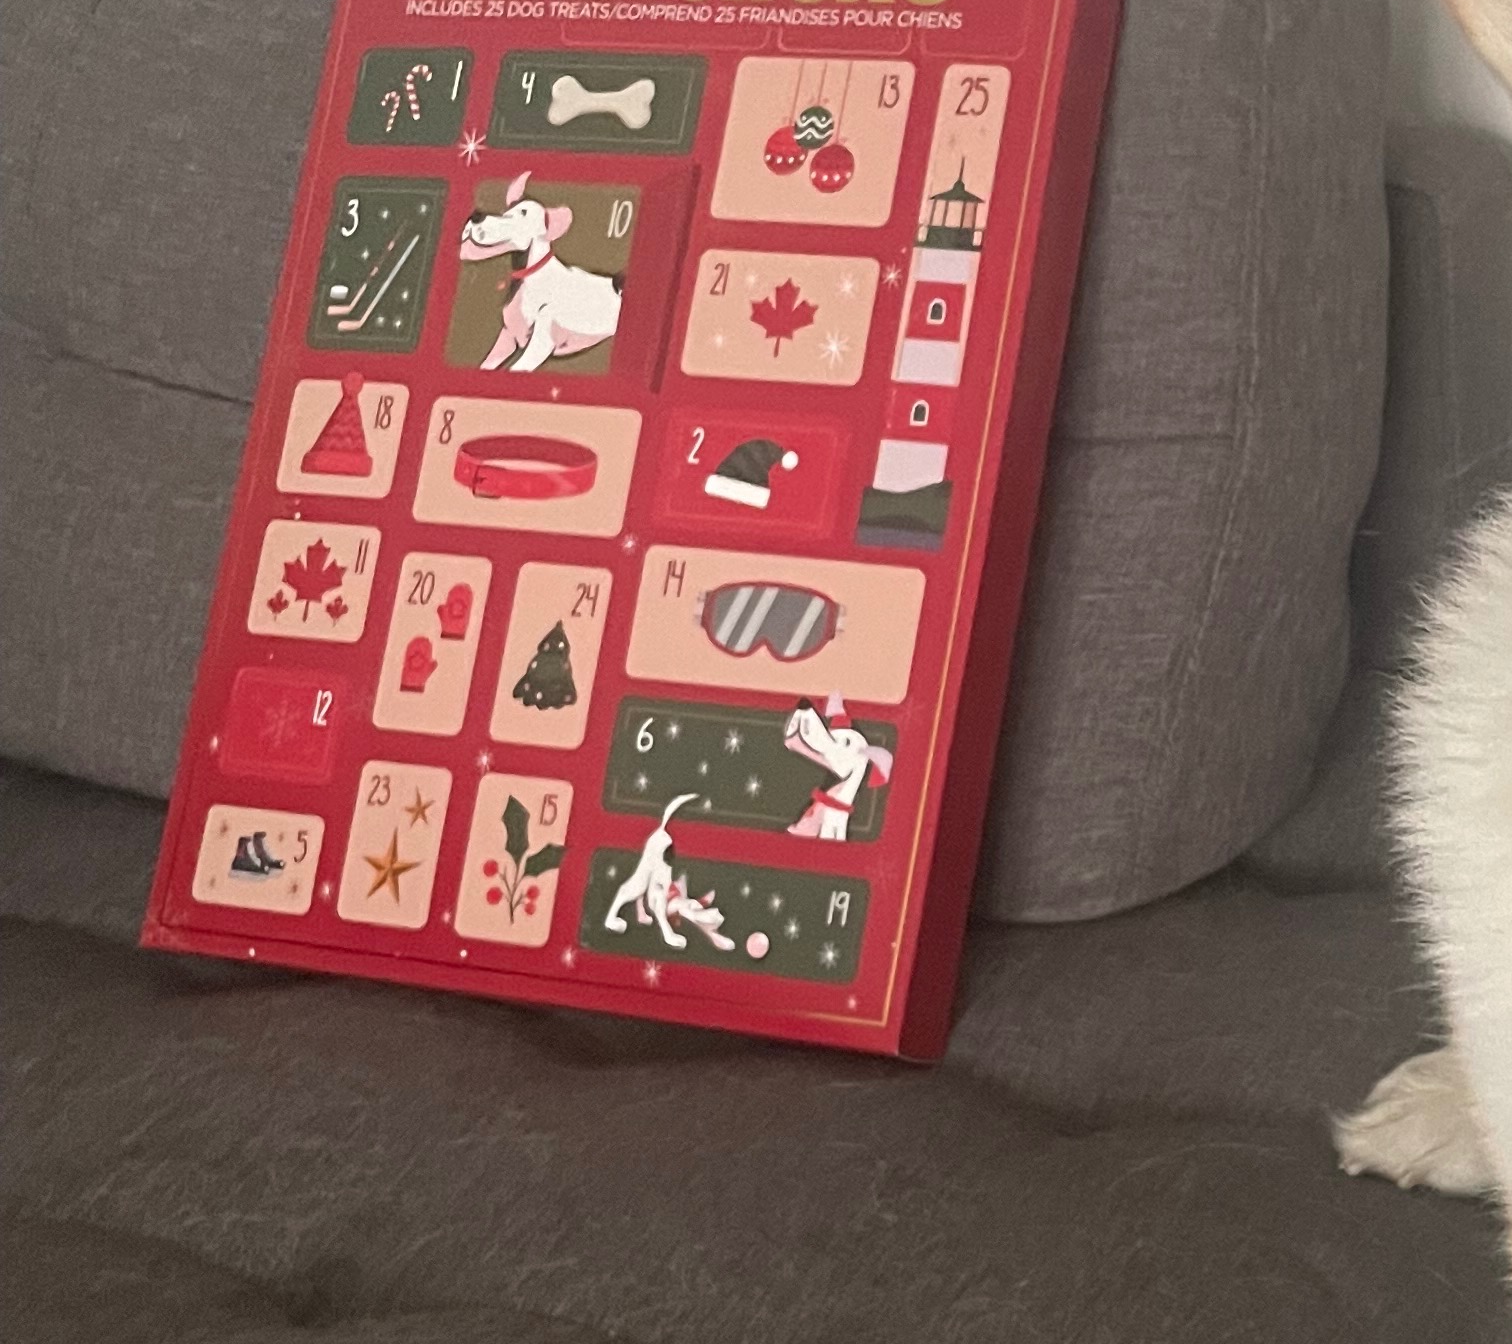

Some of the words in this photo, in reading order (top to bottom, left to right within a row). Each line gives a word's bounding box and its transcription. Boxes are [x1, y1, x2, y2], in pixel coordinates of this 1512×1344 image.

[405, 0, 483, 17] INCLUDES
[484, 0, 505, 17] 25
[507, 0, 545, 18] DOG
[714, 6, 736, 24] 25
[738, 6, 840, 26] FRIANDISES
[843, 9, 893, 27] POUR
[896, 11, 963, 30] CHIENS
[451, 60, 463, 101] 1
[521, 71, 536, 105] 4
[877, 74, 901, 109] 13
[955, 76, 990, 117] 25
[341, 199, 360, 238] 3
[607, 200, 633, 239] 10
[709, 262, 731, 296] 21
[373, 395, 394, 430] 18
[438, 410, 455, 445] 8
[687, 427, 705, 465] 2
[354, 539, 369, 575] 11
[406, 570, 436, 606] 20
[663, 559, 687, 598] 14
[570, 583, 600, 619] 24
[312, 689, 333, 727] 12
[636, 717, 655, 754] 6
[366, 775, 391, 808] 23
[538, 793, 559, 827] 15
[293, 830, 309, 865] 5
[826, 890, 851, 928] 19
